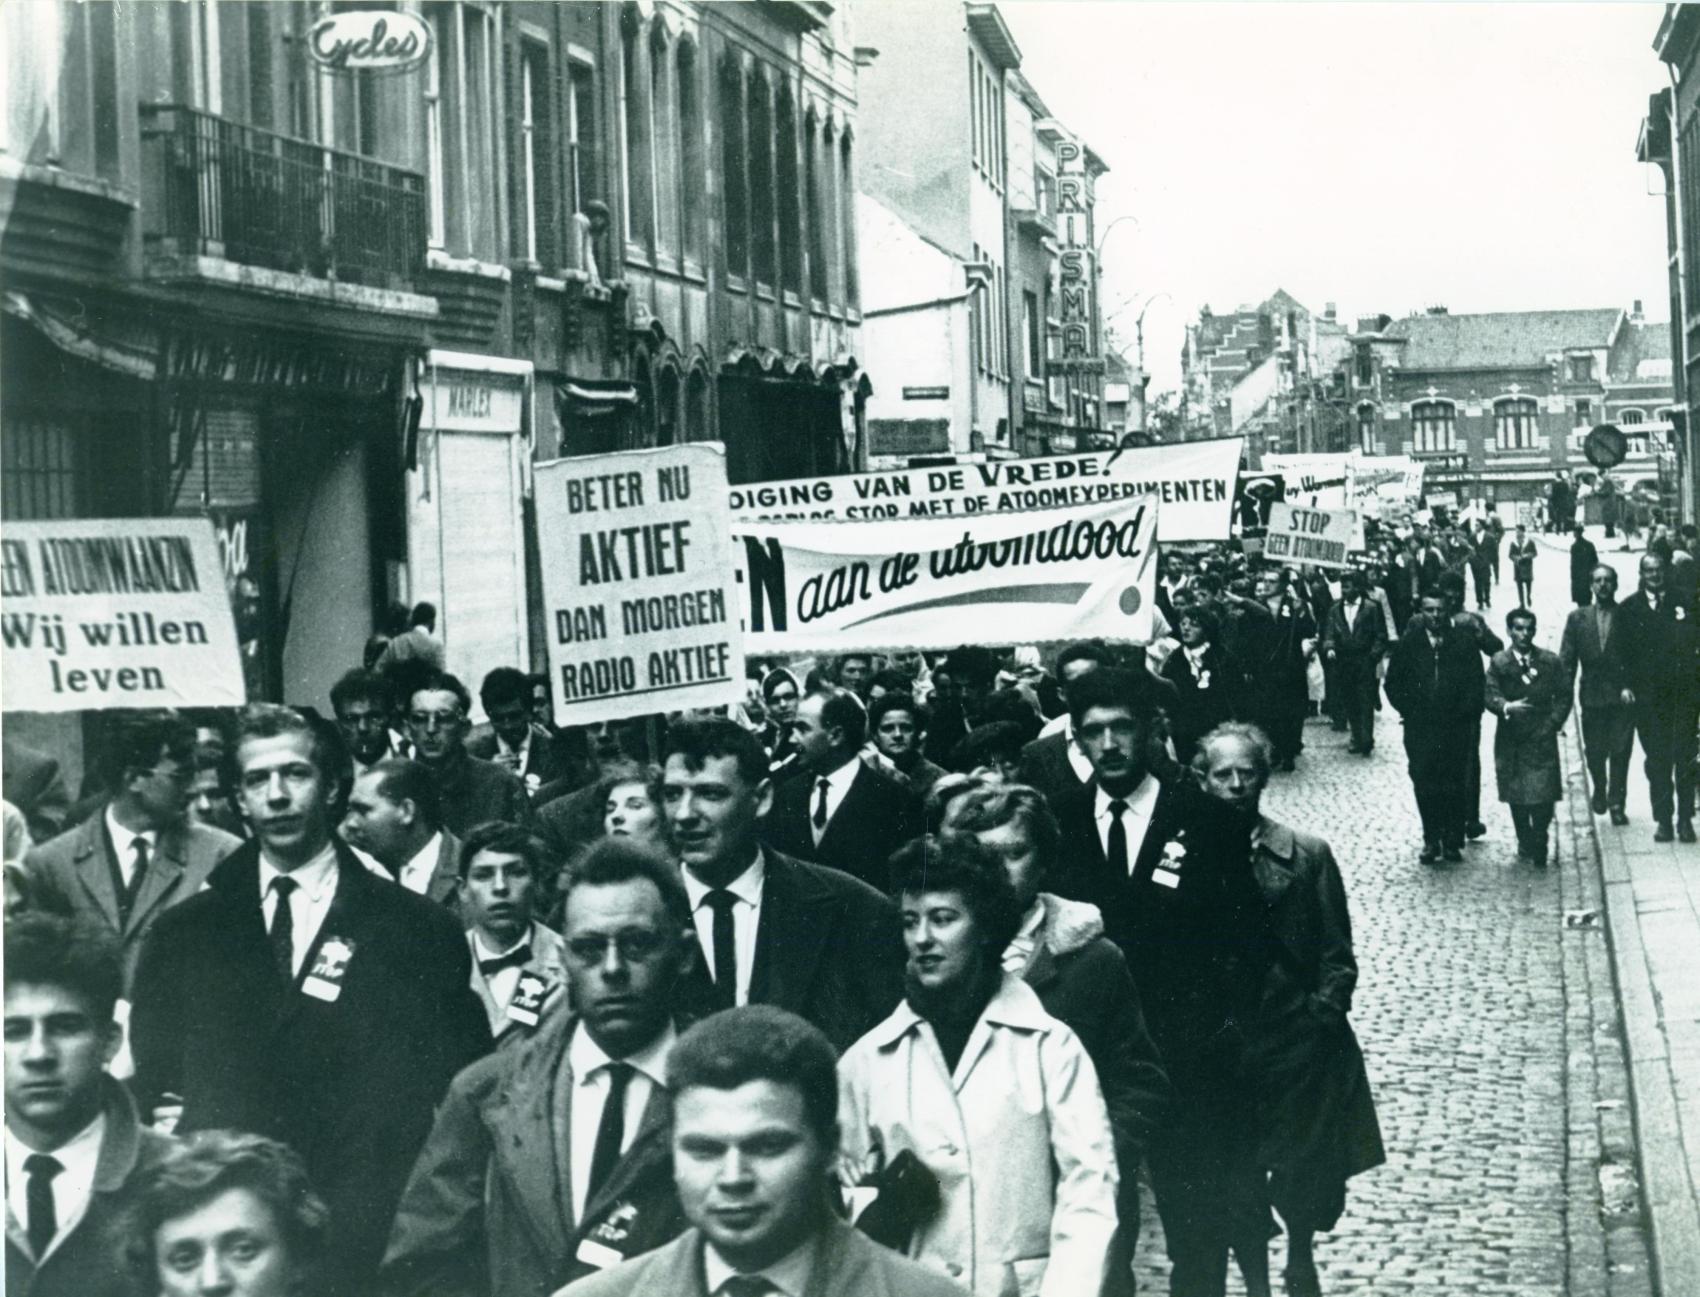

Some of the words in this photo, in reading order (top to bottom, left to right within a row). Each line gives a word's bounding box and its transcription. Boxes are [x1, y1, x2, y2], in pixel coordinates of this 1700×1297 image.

[313, 18, 419, 69] Cycles
[1055, 141, 1088, 357] PRISMA
[566, 470, 644, 514] BETER
[657, 465, 691, 502] NU
[854, 475, 911, 499] VAN
[928, 470, 965, 493] DE
[977, 449, 1124, 487] VREDE!
[909, 498, 955, 517] MET
[1289, 509, 1332, 535] STOP
[579, 520, 691, 586] AKTIEF
[797, 561, 872, 623] aan
[879, 552, 921, 593] de
[1, 613, 67, 656] Wij
[80, 611, 210, 647] willen
[555, 604, 607, 645] DAN
[621, 588, 727, 636] MORGEN
[49, 659, 165, 693] leven
[561, 655, 636, 699] RADIO
[648, 642, 730, 686] AKTIEF
